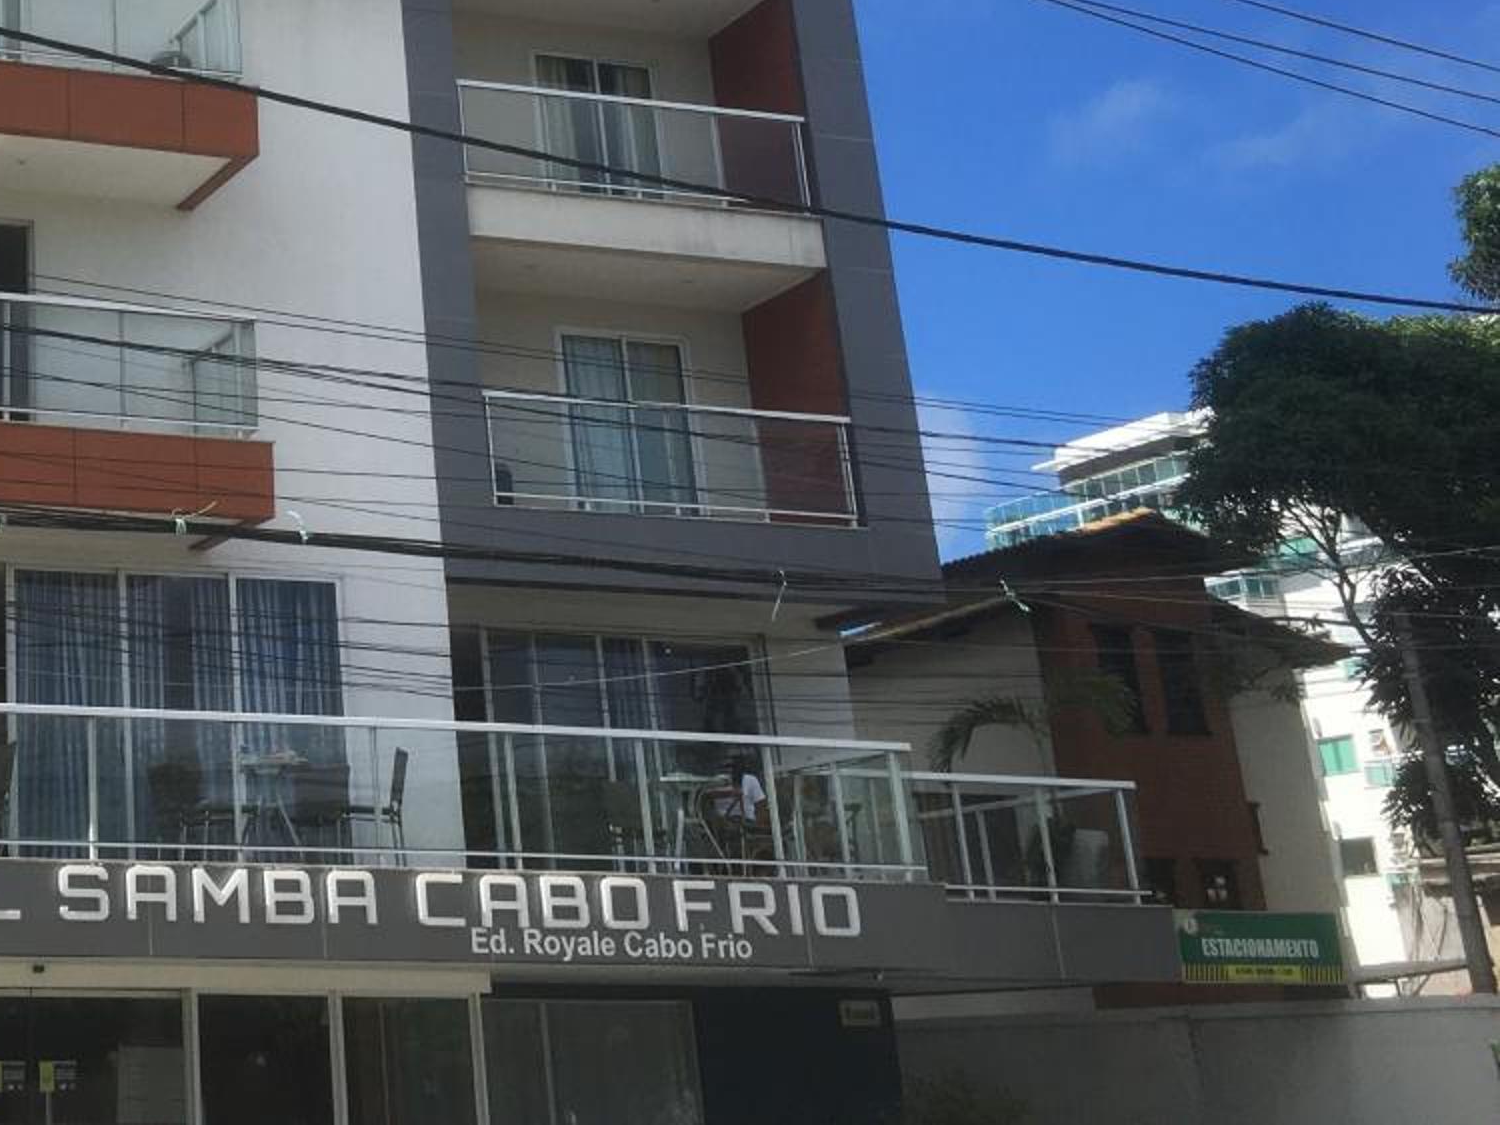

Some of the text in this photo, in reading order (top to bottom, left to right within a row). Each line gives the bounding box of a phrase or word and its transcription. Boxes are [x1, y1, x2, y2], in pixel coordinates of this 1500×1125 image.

[57, 864, 378, 925] SAMBA
[415, 872, 650, 931] CABO
[672, 879, 862, 938] FRIO
[470, 927, 753, 962] Ed. Royale Cabo Frio
[1201, 938, 1319, 958] ESTACIONAMENTO
